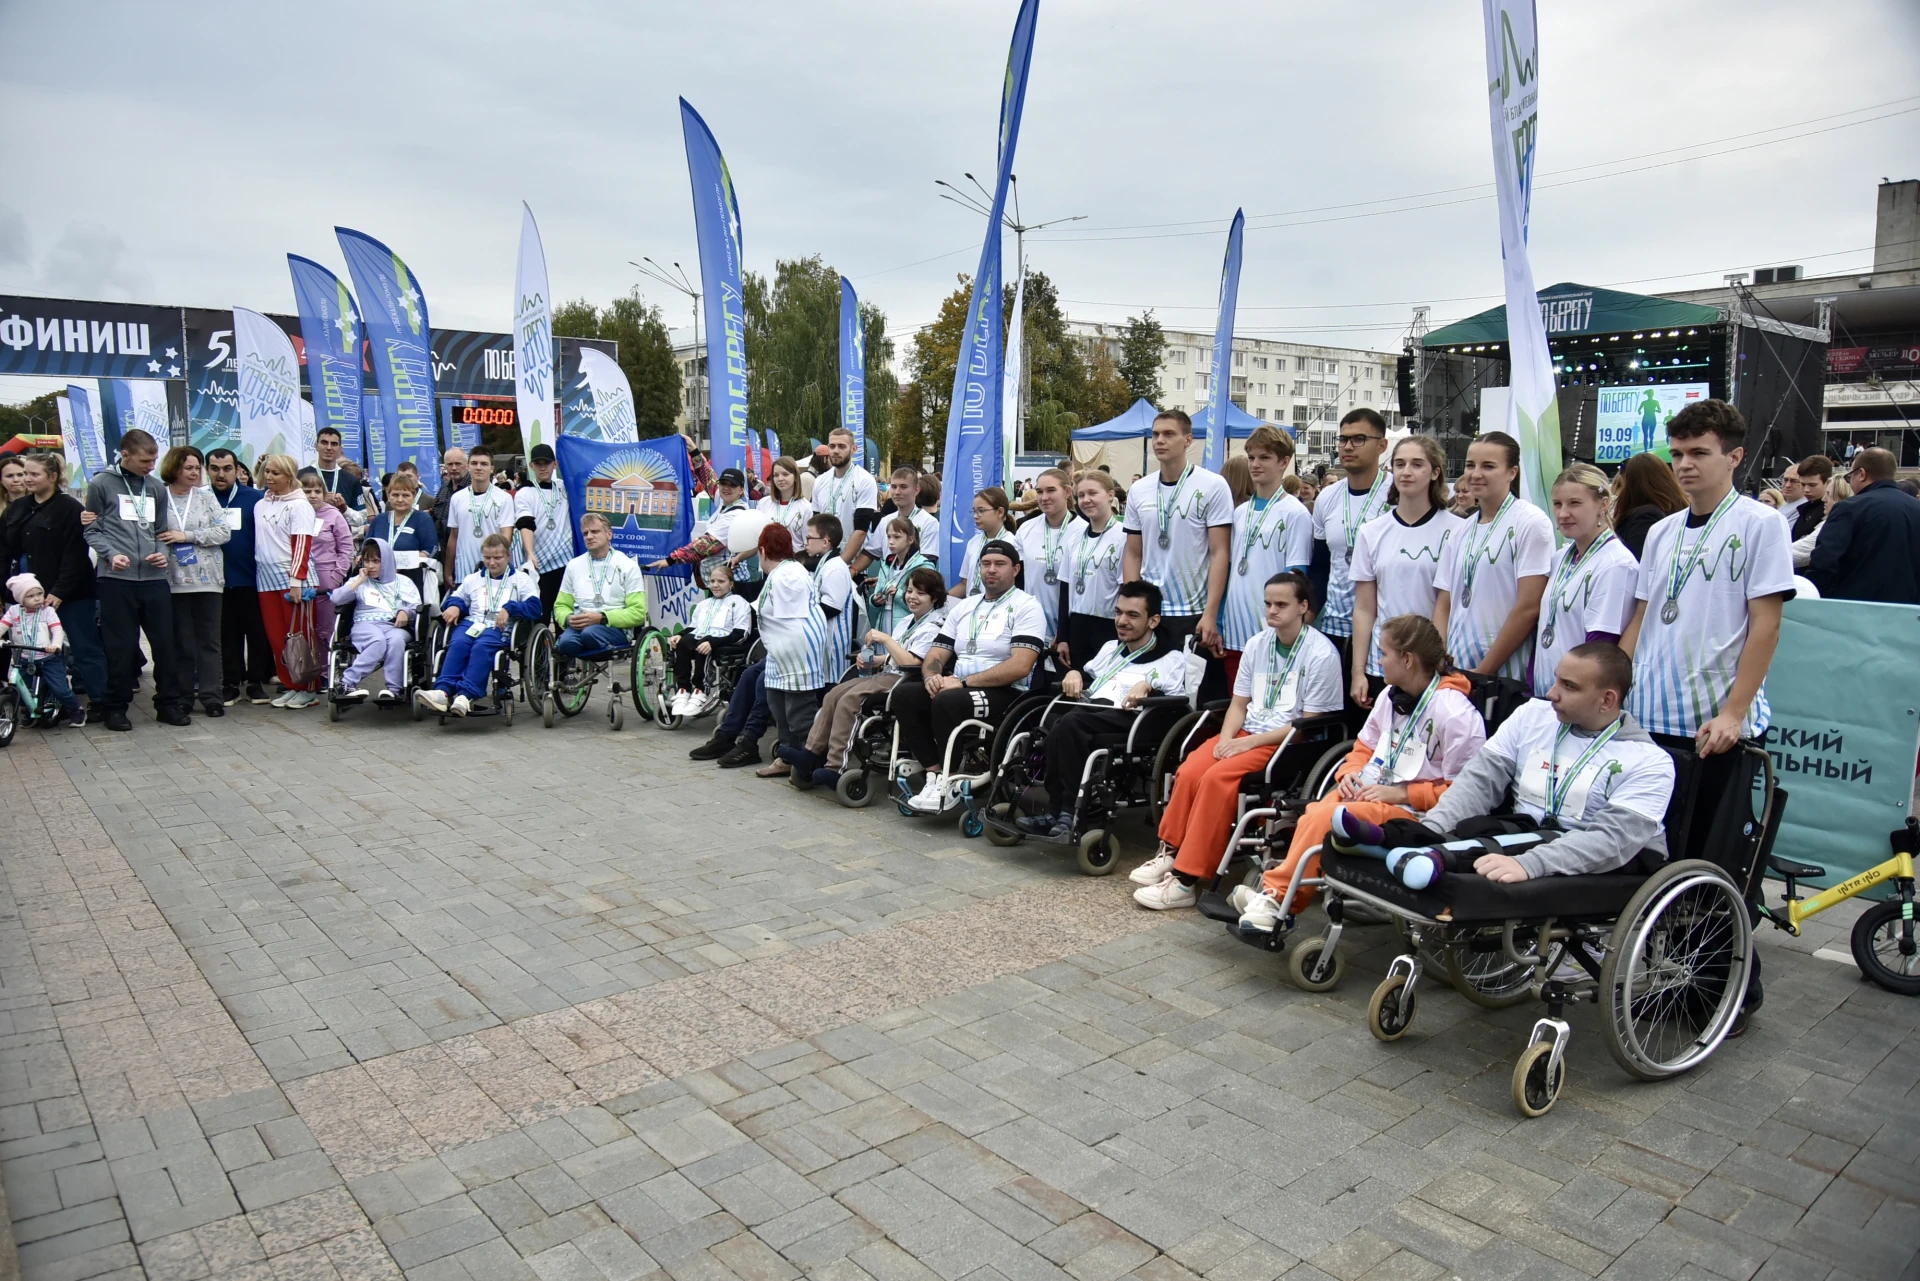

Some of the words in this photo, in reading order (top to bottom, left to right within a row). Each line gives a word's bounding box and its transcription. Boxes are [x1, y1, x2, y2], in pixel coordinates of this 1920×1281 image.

[1549, 298, 1593, 333] БЕРЕГУ
[0, 314, 150, 356] ФИНИШ
[203, 330, 233, 370] 5
[385, 338, 432, 416] БЕРЕГУ
[484, 349, 500, 380] ПО
[319, 353, 360, 423] БЕРЕГУ
[1600, 392, 1611, 413] ПО
[1612, 391, 1641, 413] БЕРЕГУ
[463, 407, 514, 425] 0:00:00
[399, 418, 435, 447] ПО
[1599, 428, 1632, 443] 19.09
[1598, 445, 1631, 460] 2026
[1765, 725, 1843, 754] СКИЙ
